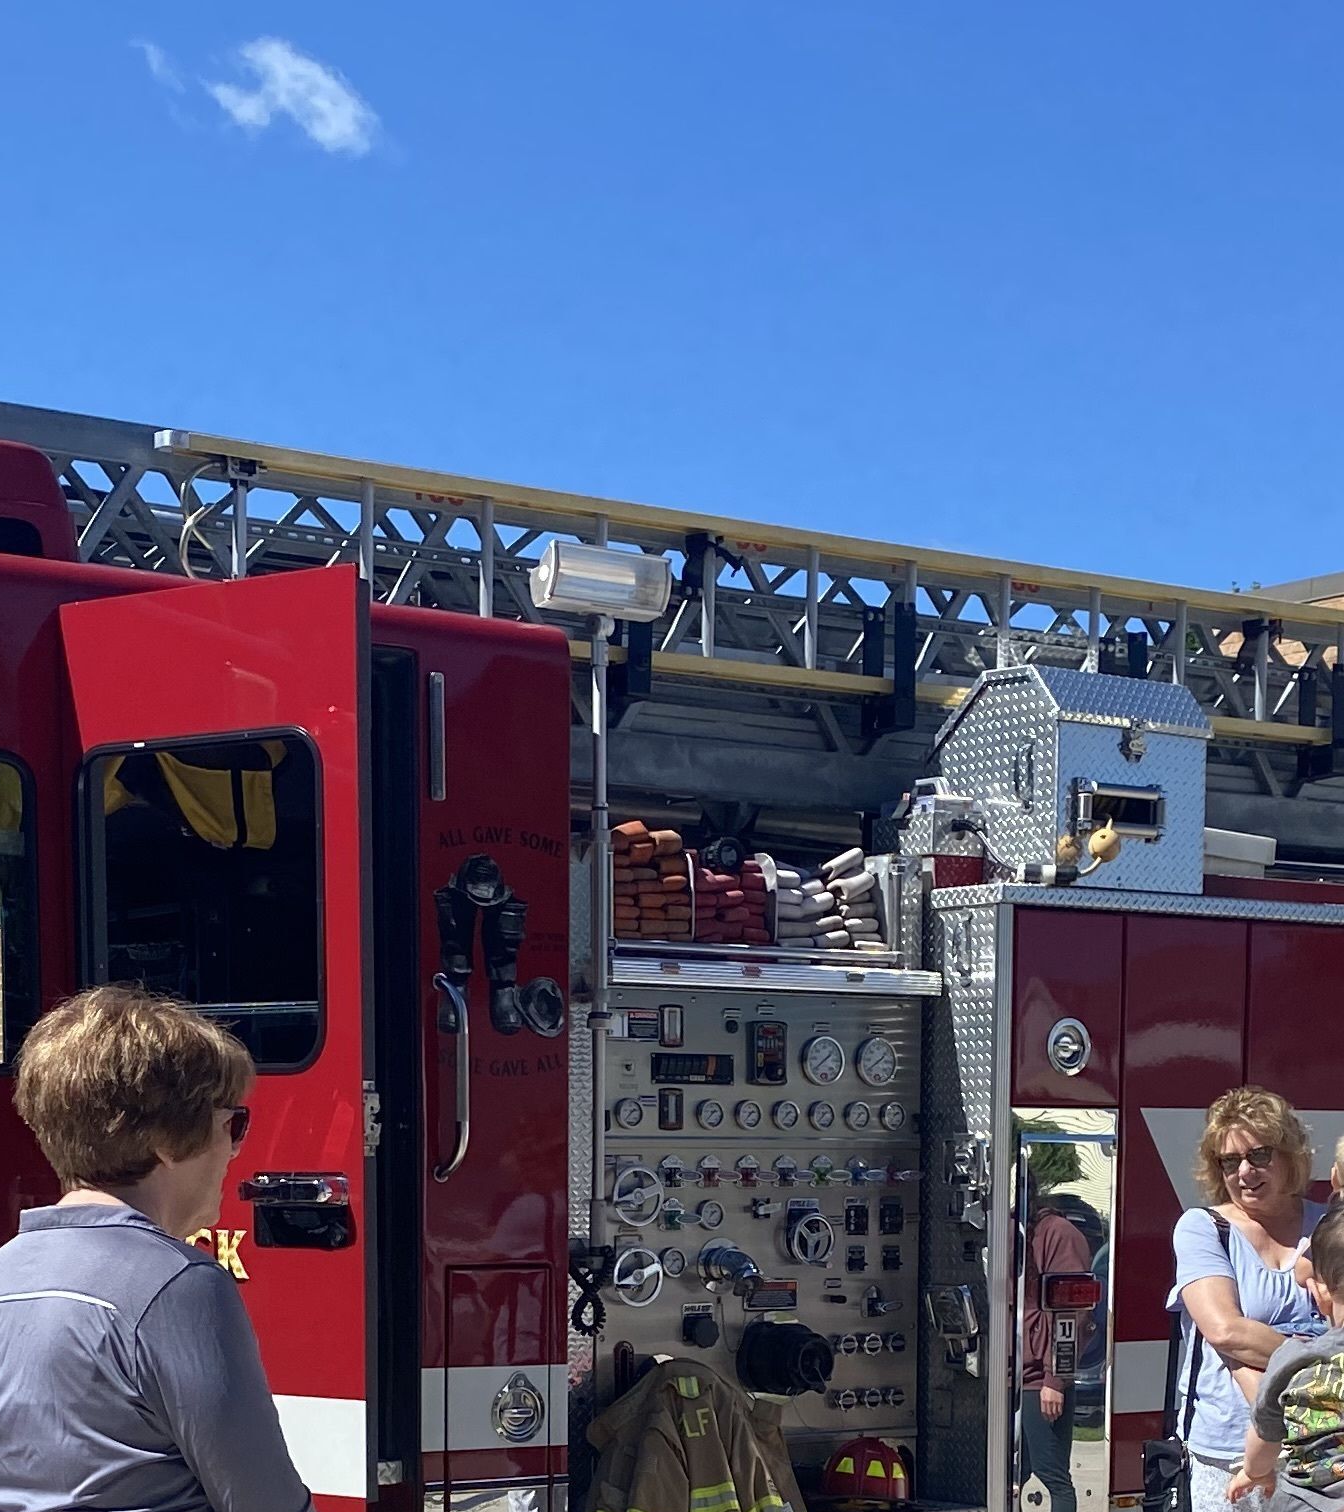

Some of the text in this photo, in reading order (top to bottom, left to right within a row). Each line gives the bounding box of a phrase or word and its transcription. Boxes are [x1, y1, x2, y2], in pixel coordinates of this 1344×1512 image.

[437, 826, 564, 858] ALL GAVE SOME
[489, 1052, 564, 1077] GAVE ALL
